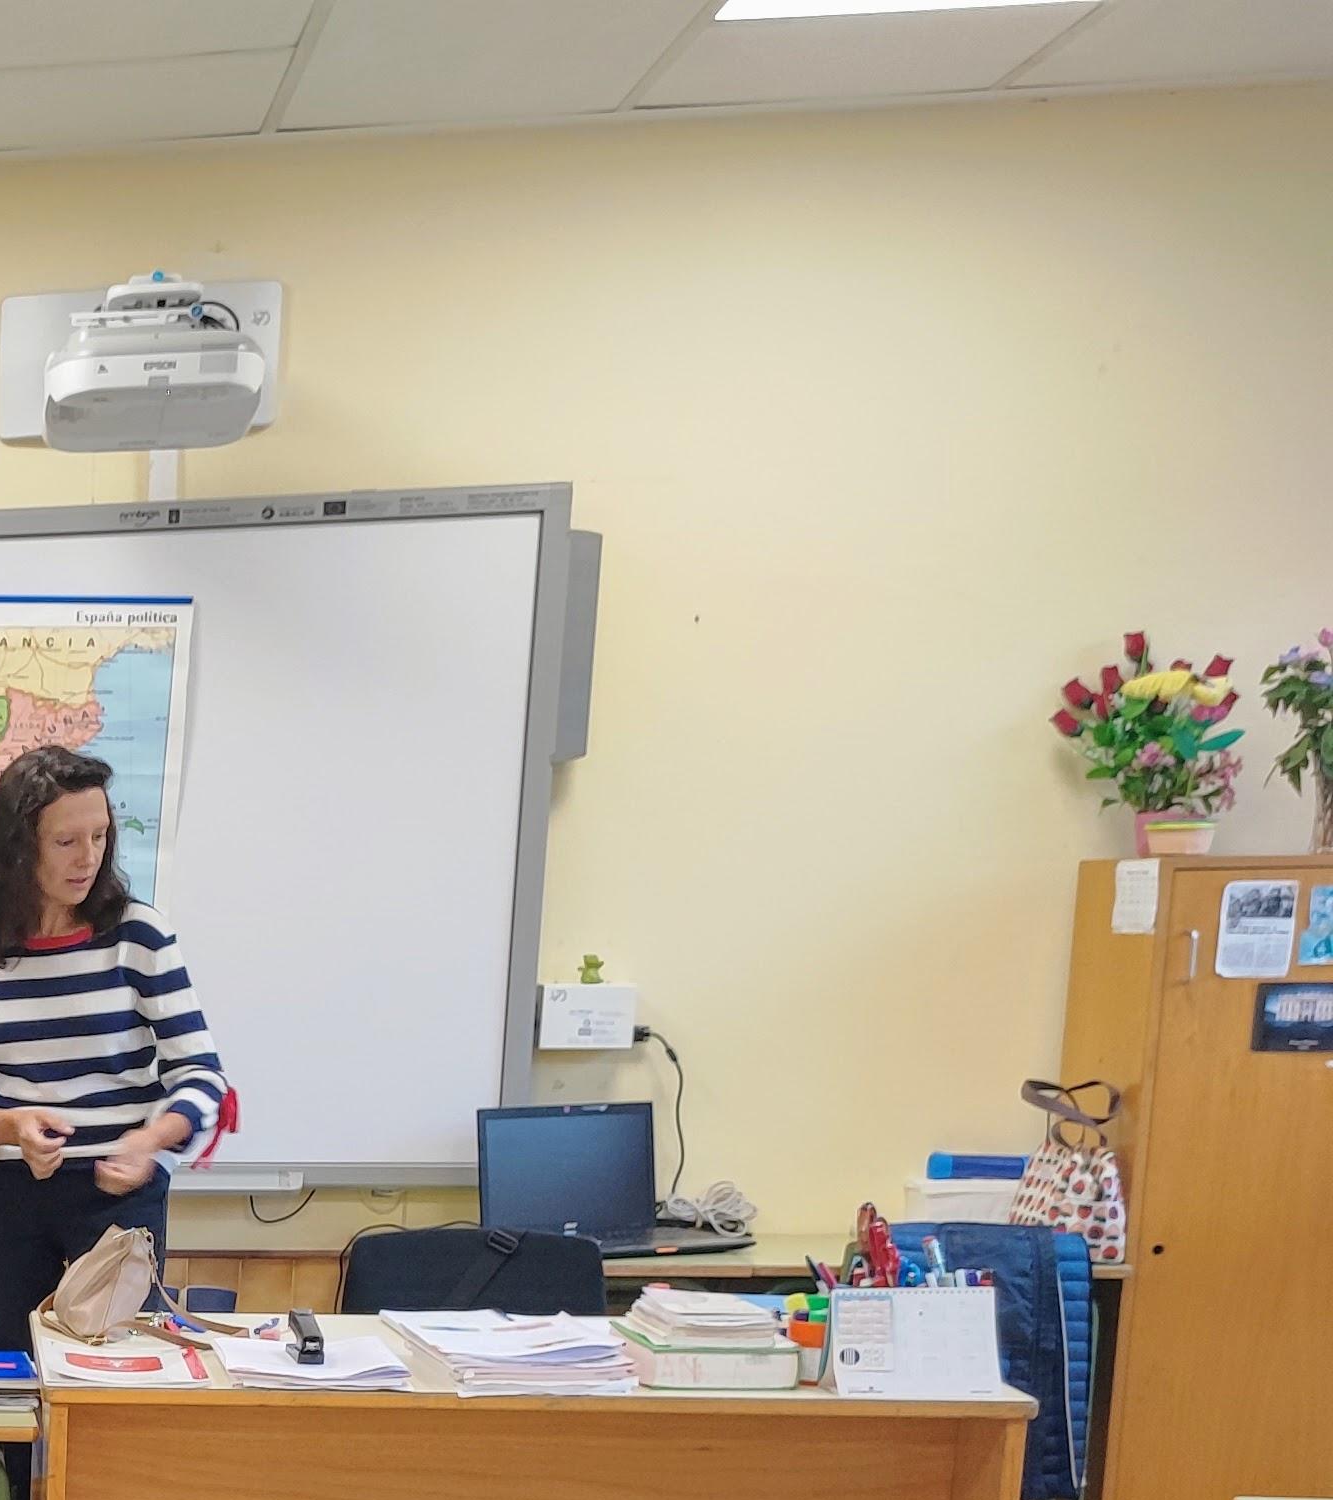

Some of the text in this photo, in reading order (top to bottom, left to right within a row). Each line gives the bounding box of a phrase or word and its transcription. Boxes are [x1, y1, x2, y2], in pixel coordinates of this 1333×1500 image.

[143, 360, 177, 371] EPSON
[76, 611, 178, 624] España política
